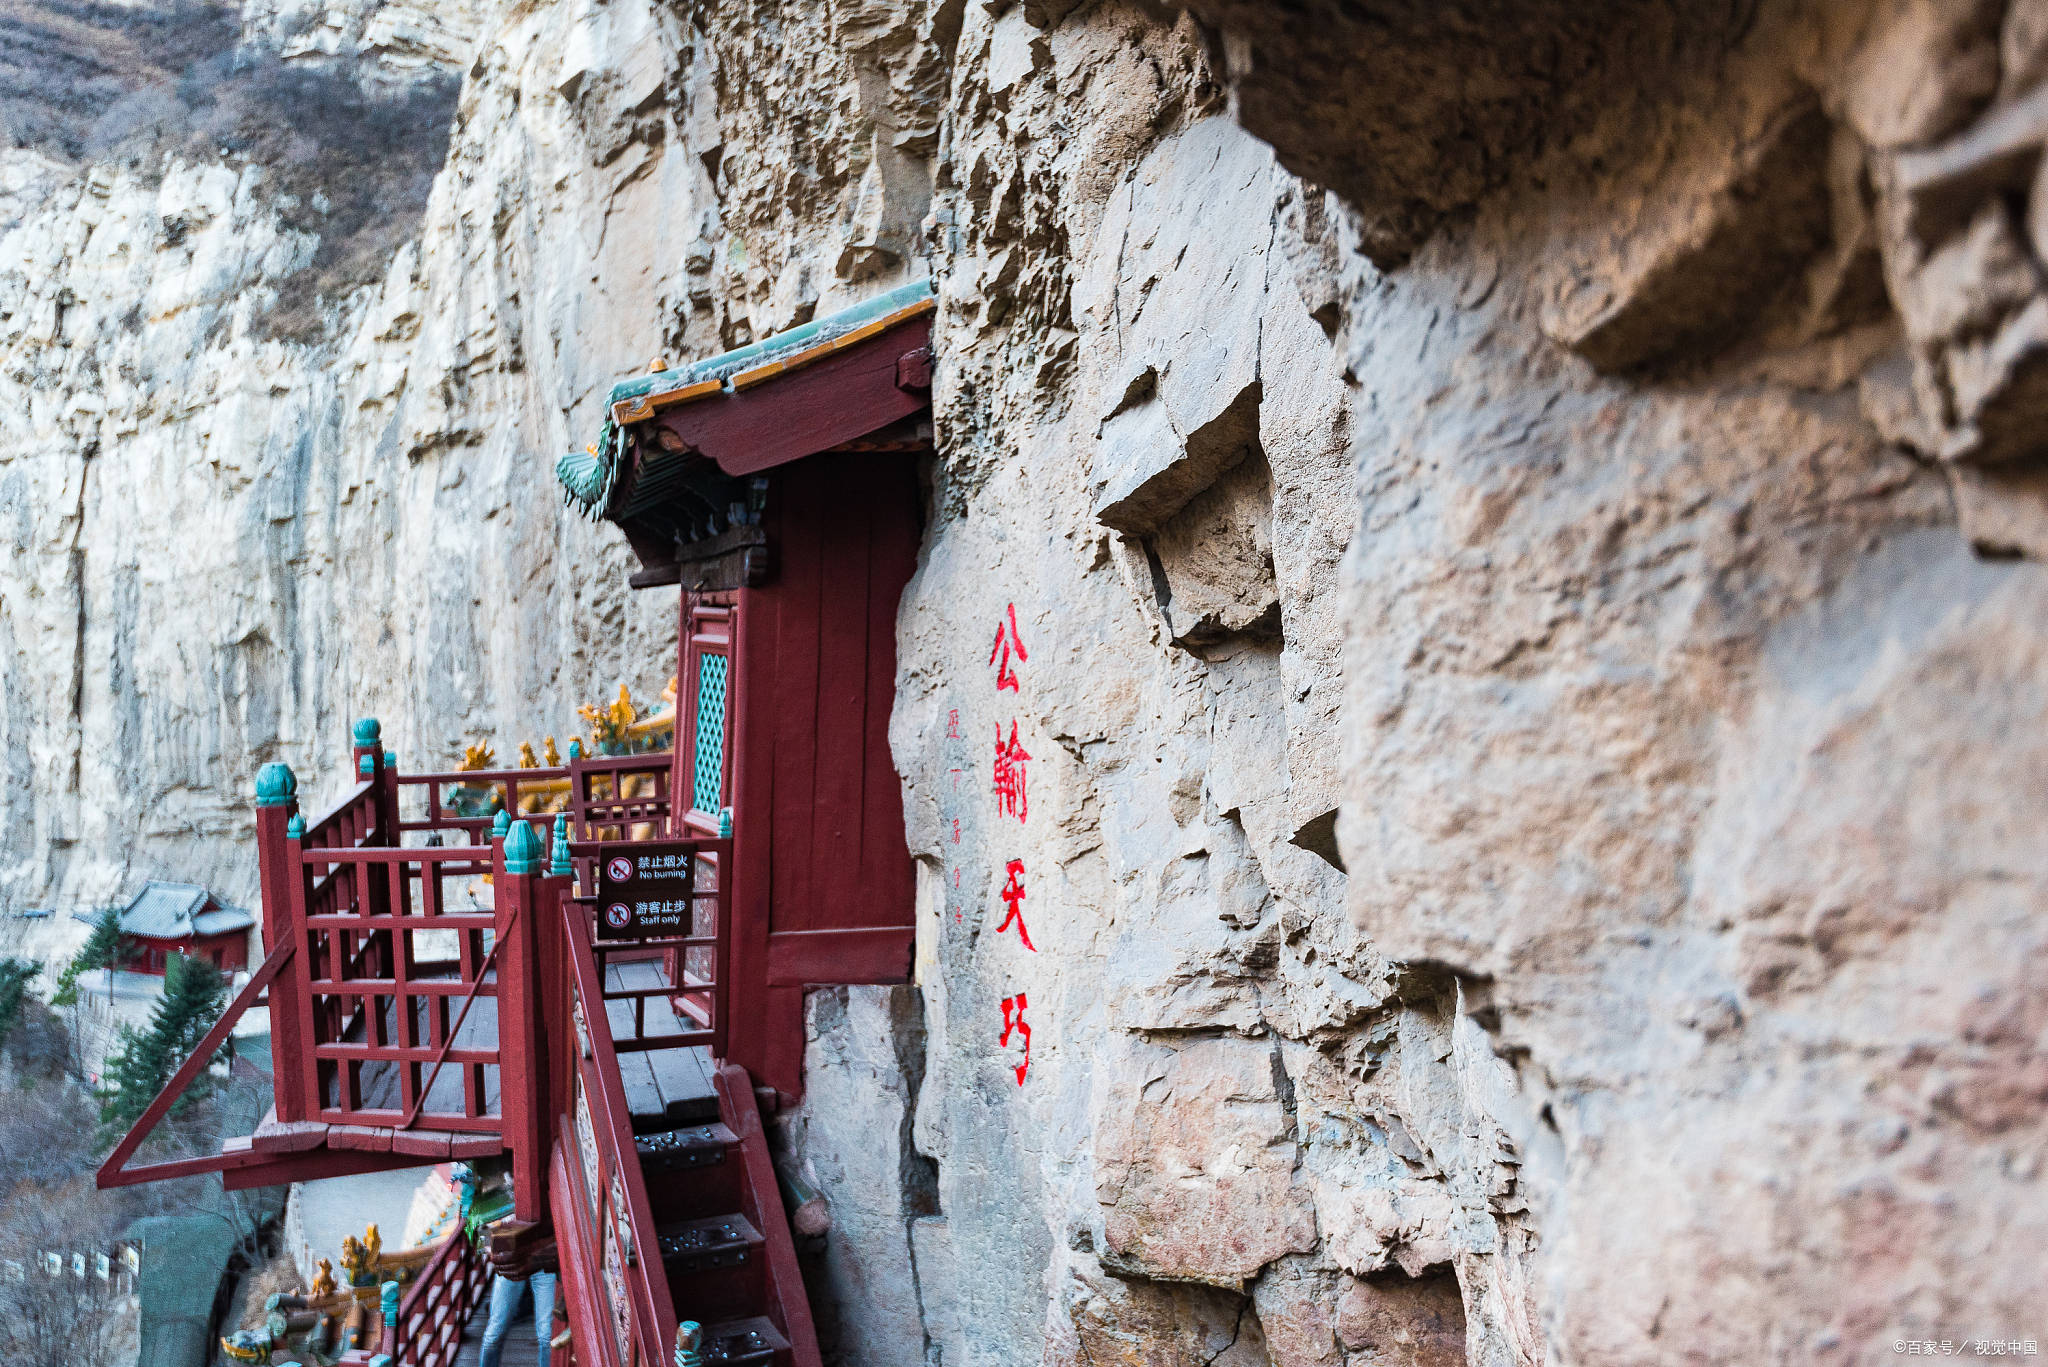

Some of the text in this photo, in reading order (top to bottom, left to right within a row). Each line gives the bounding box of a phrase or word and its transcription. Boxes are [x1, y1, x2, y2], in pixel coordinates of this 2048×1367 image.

[638, 855, 688, 869] 禁止烟火
[640, 869, 686, 879] No burning
[636, 900, 685, 914] 游客止步
[640, 914, 680, 925] Staff only
